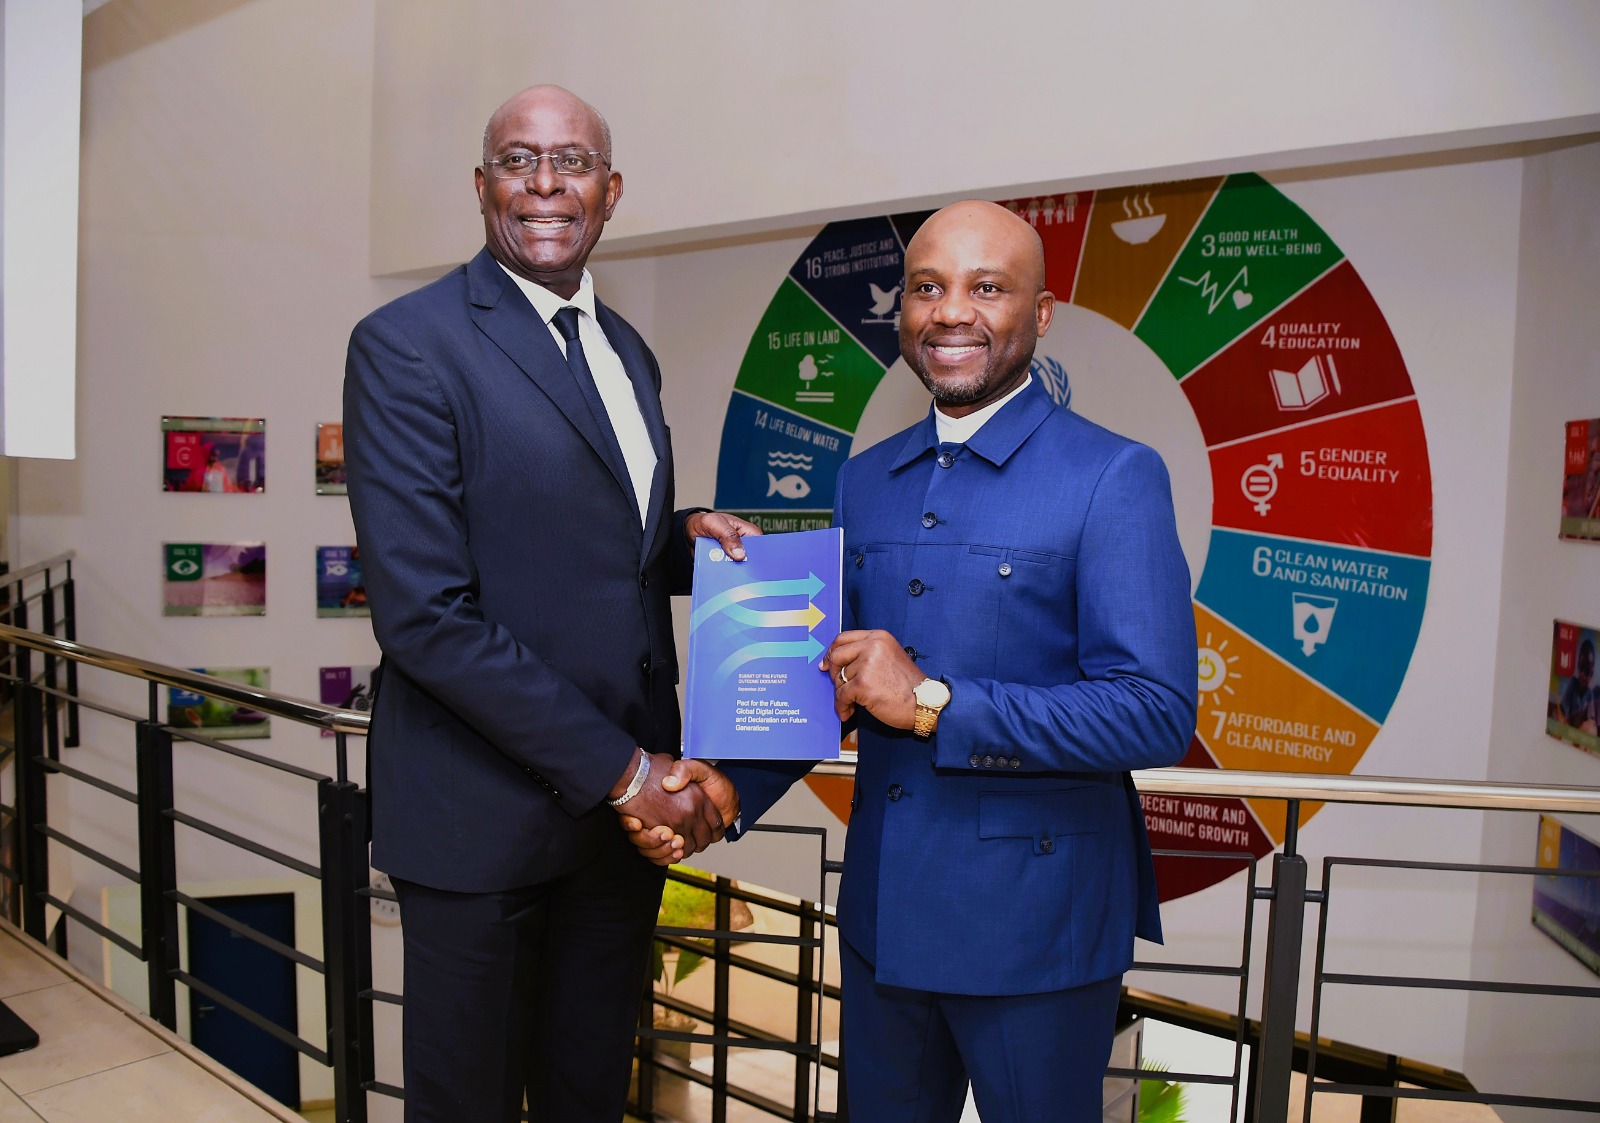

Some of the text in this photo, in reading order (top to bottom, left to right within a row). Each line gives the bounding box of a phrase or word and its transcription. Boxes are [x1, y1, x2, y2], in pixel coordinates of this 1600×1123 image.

[1201, 234, 1216, 257] 3
[1219, 229, 1298, 243] GOOD HEALTH
[850, 241, 877, 258] JUSTICE
[879, 238, 894, 251] AND
[1218, 242, 1322, 257] AND WELL-BEING
[805, 257, 822, 279] 16
[824, 252, 899, 278] STRONG INSTITUTIONS
[768, 329, 840, 350] 15 LIFE ON LAND
[1260, 325, 1276, 349] 4
[1279, 322, 1341, 336] QUALITY
[1278, 337, 1360, 350] EDUCATION
[755, 409, 840, 452] 14 LIFE BELOW WATER
[1300, 450, 1316, 476] 5
[1319, 447, 1387, 465] GENDER
[1318, 464, 1400, 484] EQUALITY
[763, 518, 797, 531] CLIMATE
[800, 518, 831, 531] ACTION
[1252, 546, 1273, 577] 6
[1274, 549, 1389, 580] CLEAN WATER
[1272, 566, 1408, 601] AND SANITATION
[755, 708, 774, 717] Digital
[774, 708, 800, 717] Compact
[735, 724, 770, 732] Generations
[1210, 710, 1227, 740] 7
[1227, 711, 1357, 747] AFFORDABLE AND
[1226, 730, 1334, 763] CLEAN ENERGY
[1139, 795, 1247, 826] DECENT WORK AND
[1144, 814, 1250, 847] CONOMIC GROWTH
